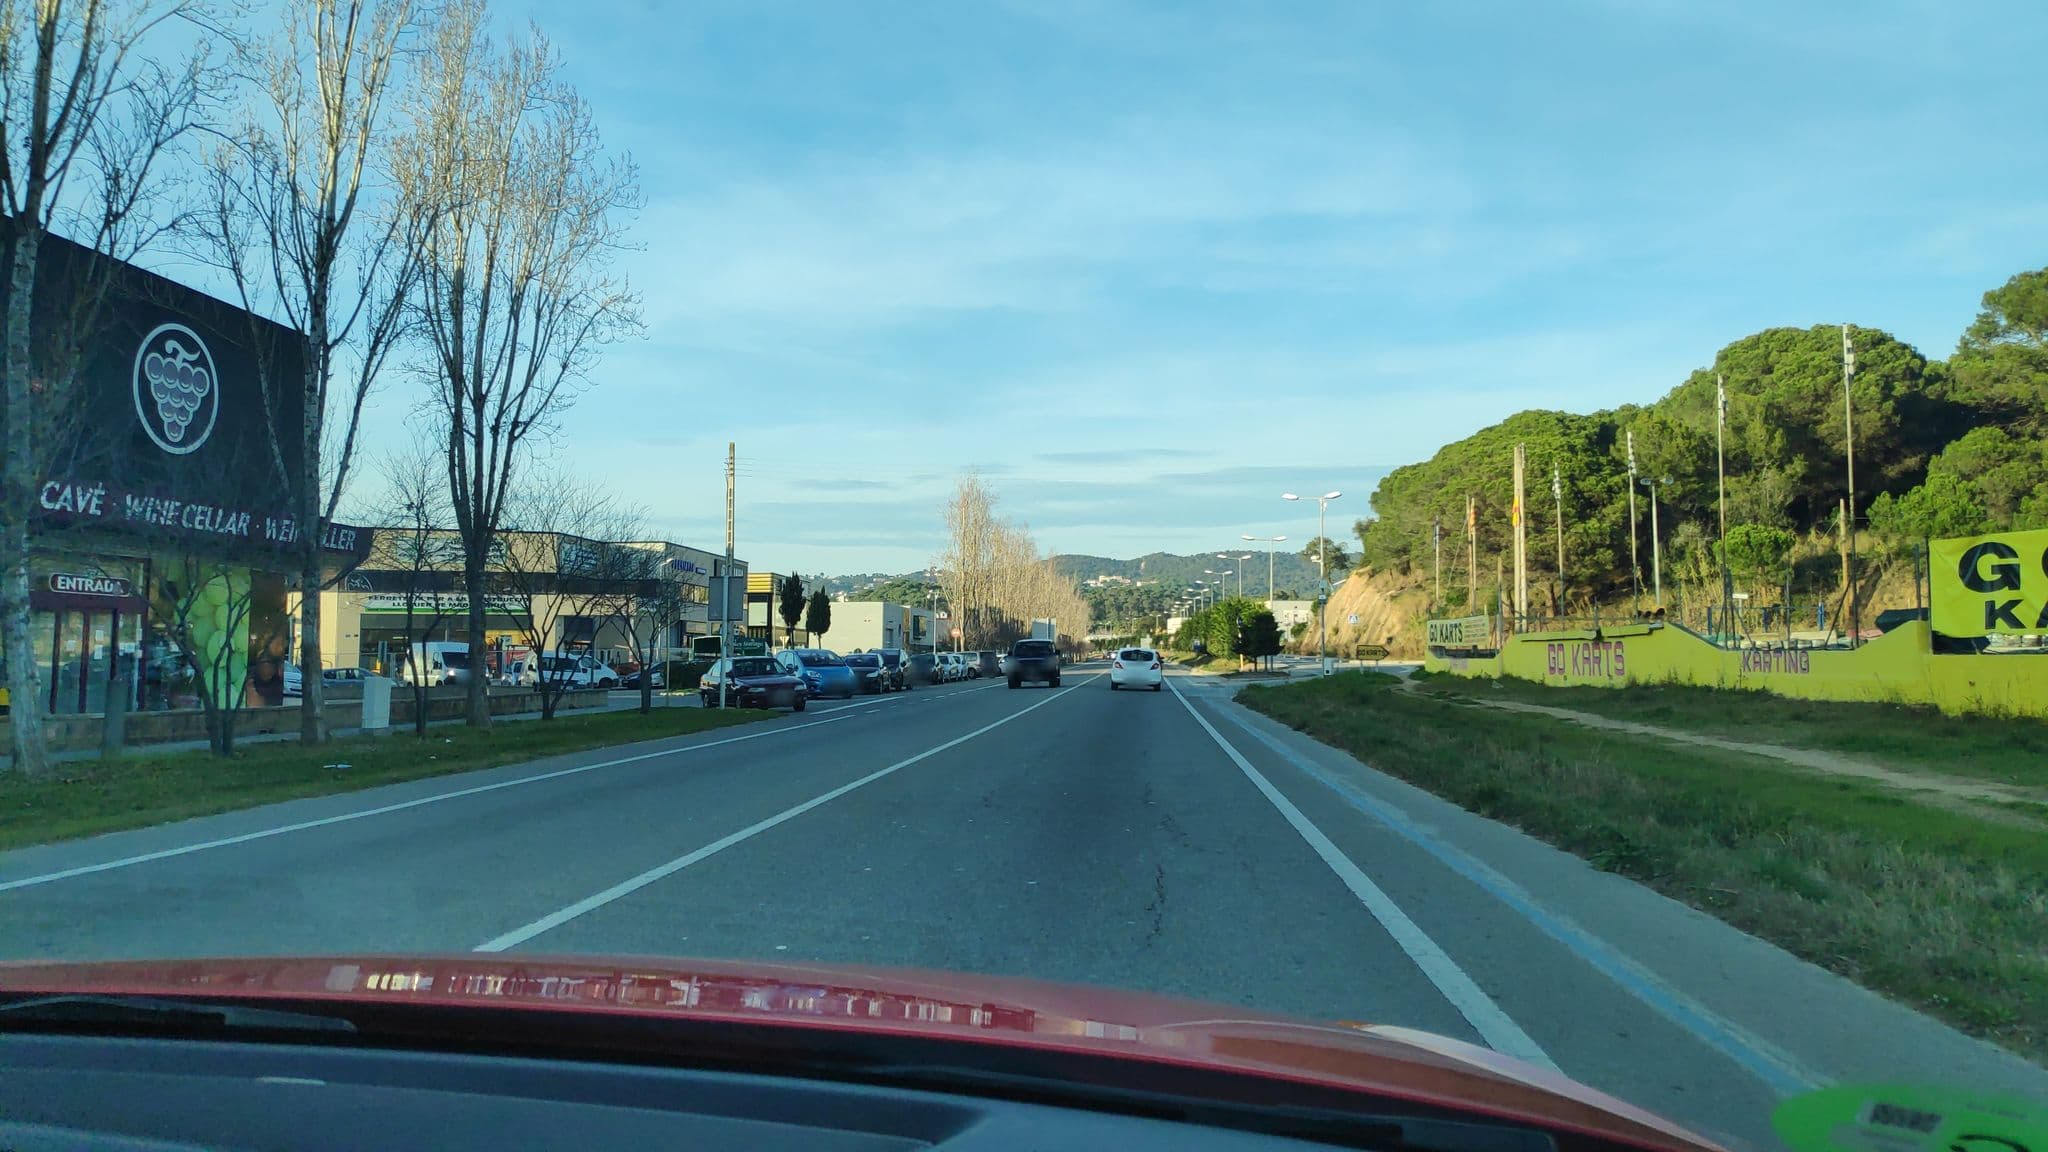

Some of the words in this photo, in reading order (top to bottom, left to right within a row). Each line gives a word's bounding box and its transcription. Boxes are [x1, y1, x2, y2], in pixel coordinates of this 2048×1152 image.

[125, 494, 181, 525] WINE
[181, 502, 251, 537] CELLAR
[1958, 541, 2048, 593] G
[1429, 623, 1438, 643] GO
[1439, 622, 1463, 643] KARTS
[1548, 643, 1566, 675] GO
[1571, 641, 1625, 677] KARTS
[1743, 648, 1810, 674] KARTING
